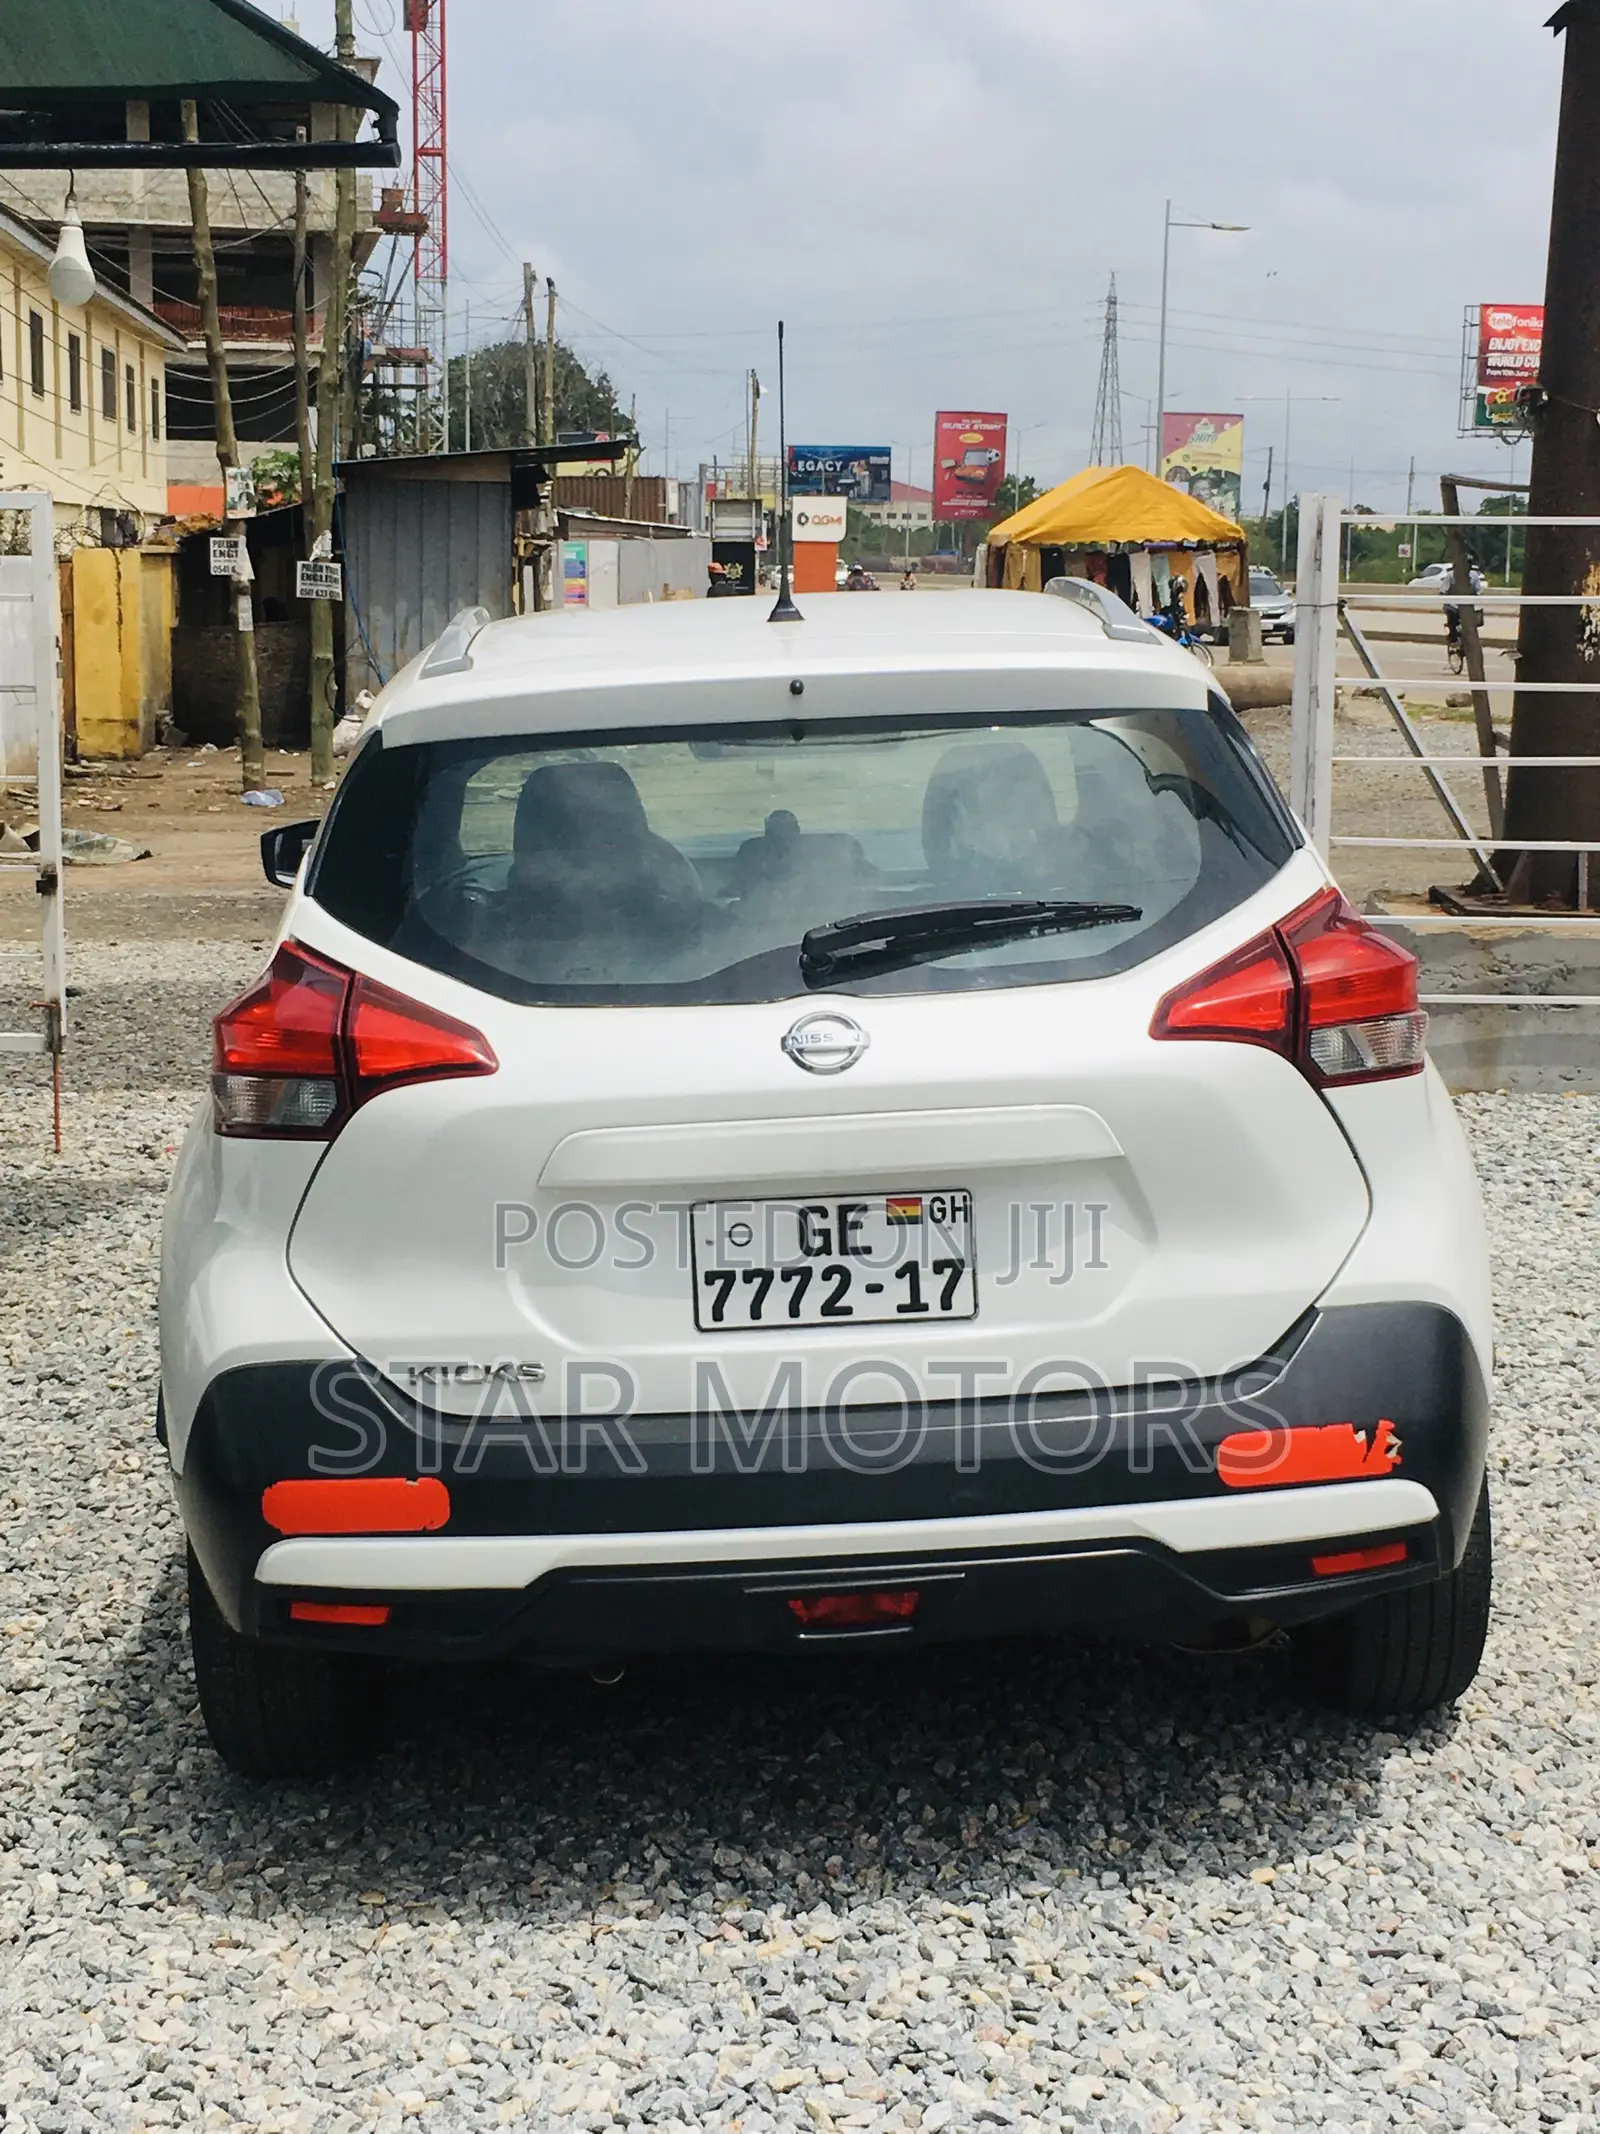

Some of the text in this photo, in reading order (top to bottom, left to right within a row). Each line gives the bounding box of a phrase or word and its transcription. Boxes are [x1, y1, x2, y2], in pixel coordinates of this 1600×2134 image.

[798, 1194, 968, 1257] GE GH
[704, 1257, 965, 1322] 7772-17
[407, 1360, 546, 1386] KICKS
